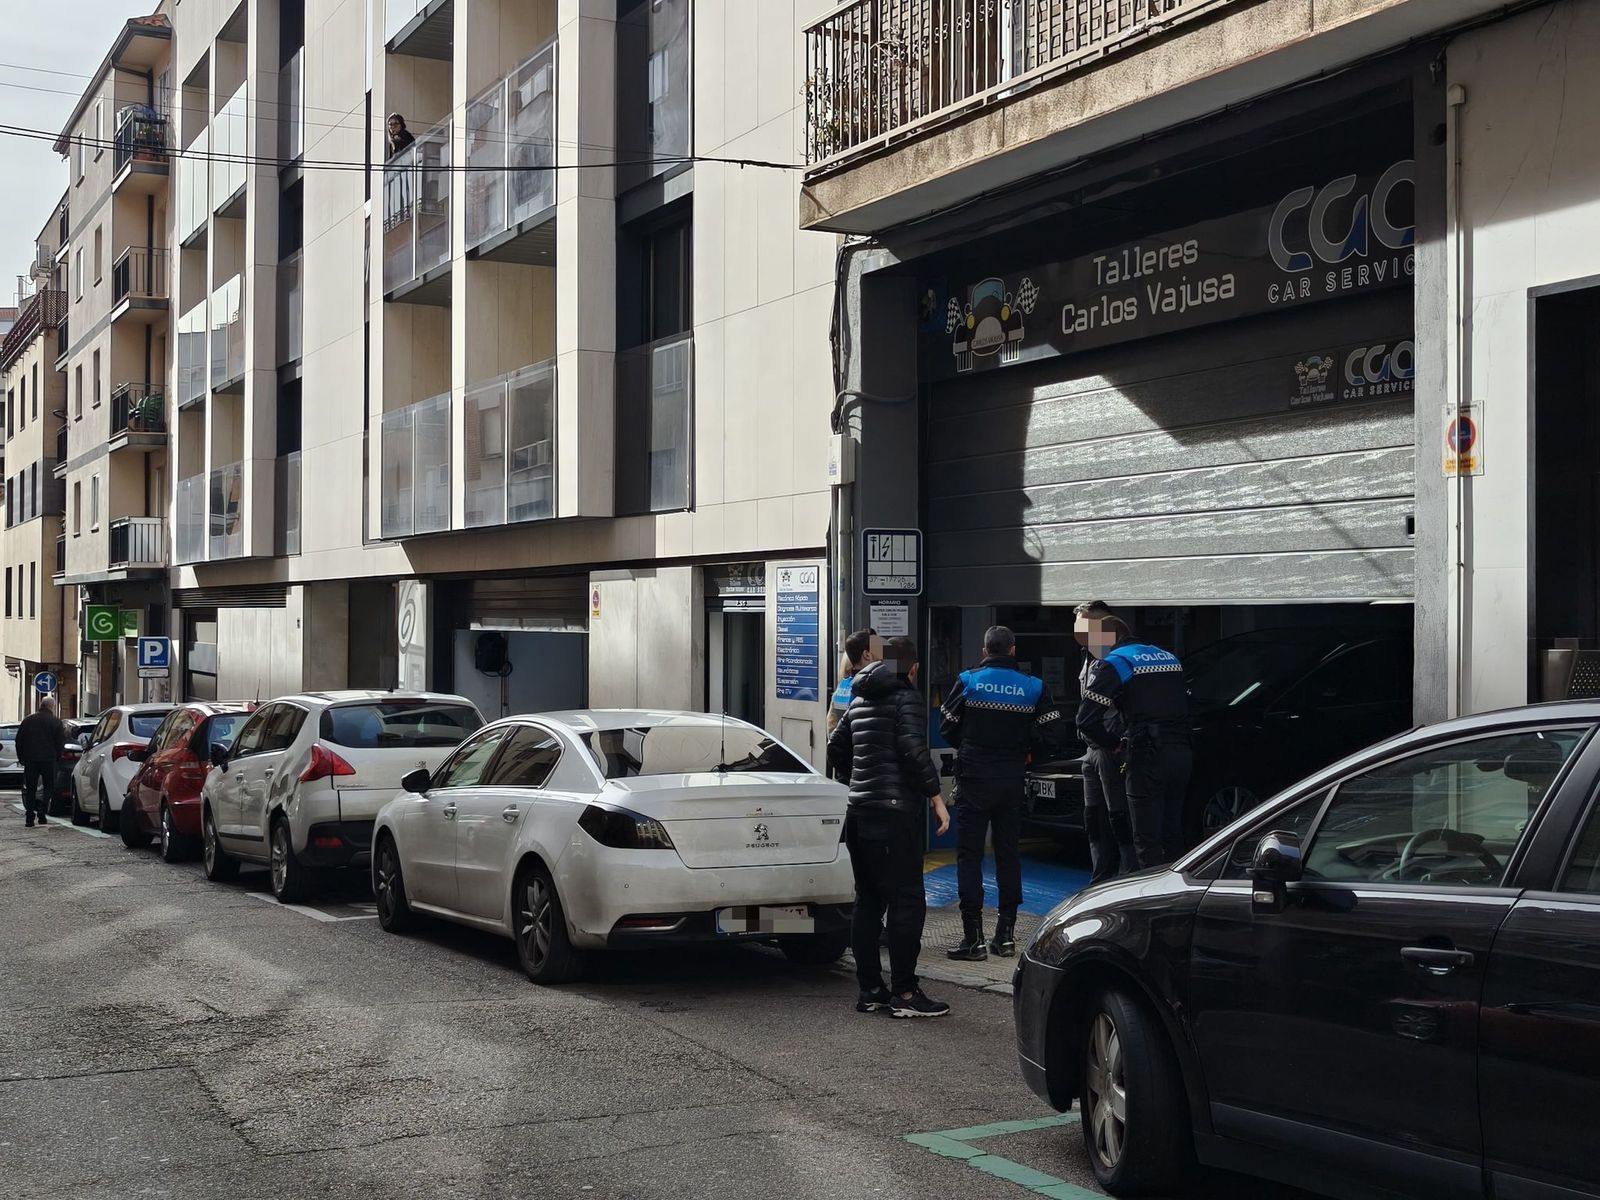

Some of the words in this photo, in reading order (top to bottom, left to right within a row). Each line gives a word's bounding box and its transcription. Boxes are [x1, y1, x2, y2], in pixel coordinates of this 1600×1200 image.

[1093, 239, 1199, 286] Talleres
[1267, 276, 1312, 304] CAR
[1061, 295, 1138, 335] Carlos
[1146, 273, 1236, 316] Vajusa
[1343, 386, 1365, 400] CAR
[144, 640, 164, 665] P
[975, 681, 1026, 697] POLICÍA
